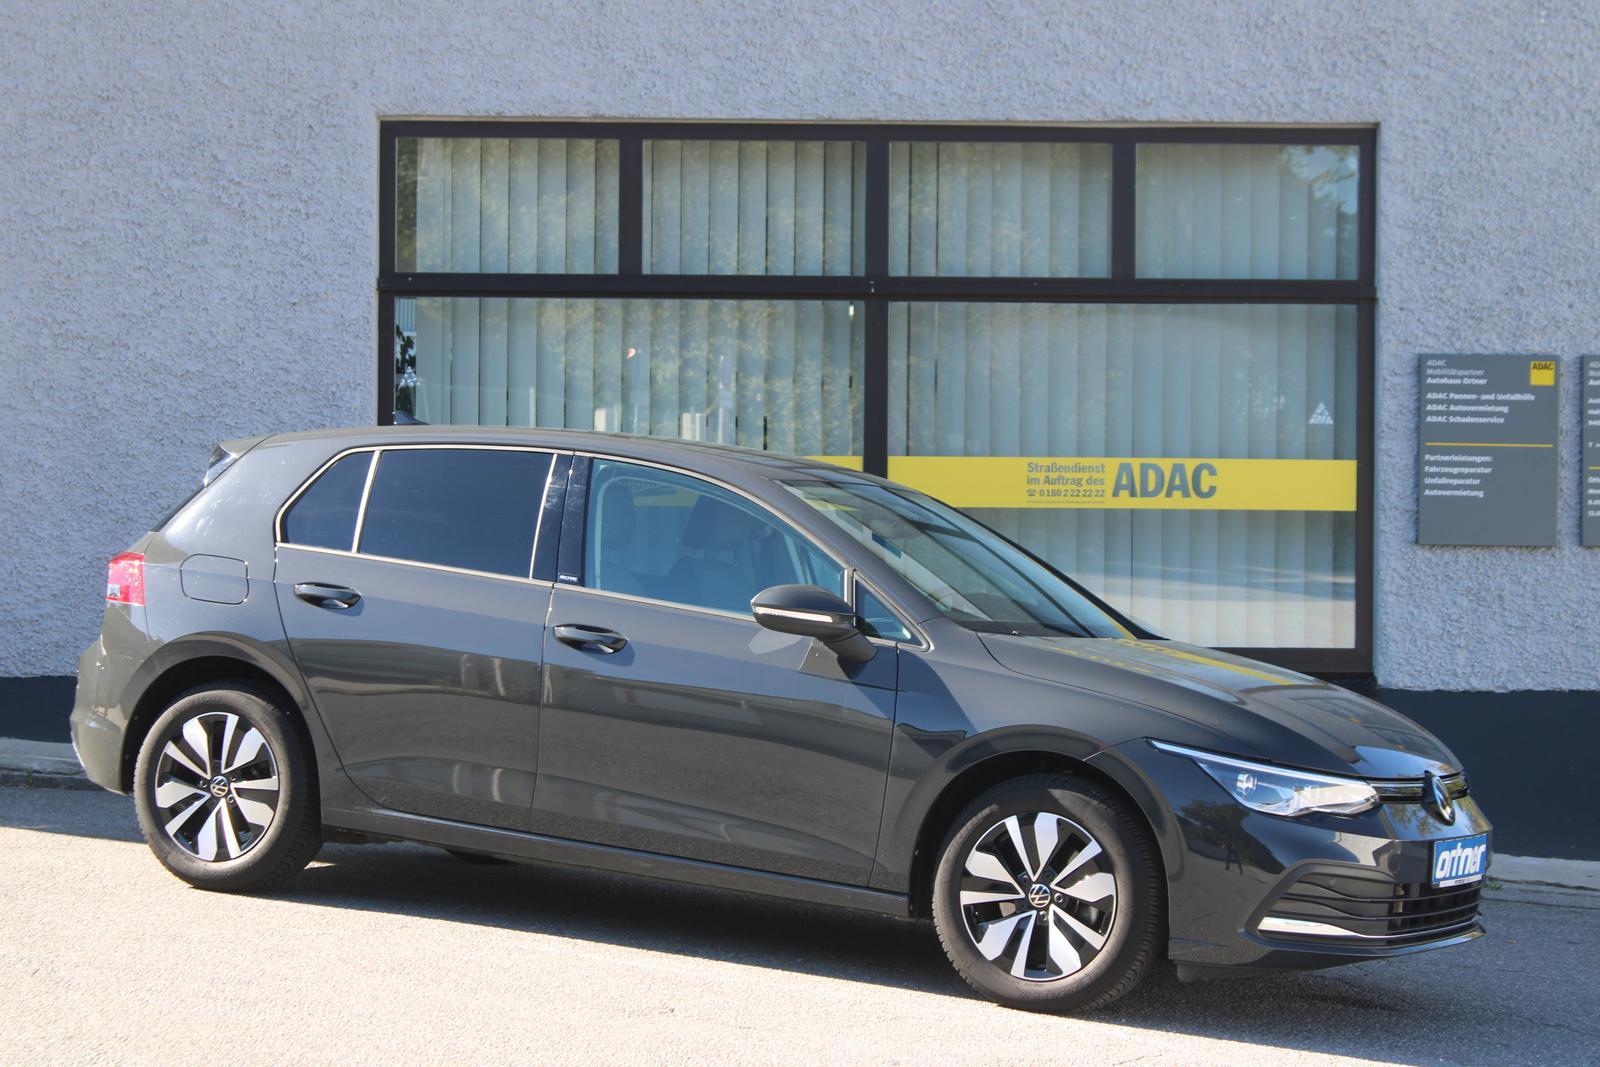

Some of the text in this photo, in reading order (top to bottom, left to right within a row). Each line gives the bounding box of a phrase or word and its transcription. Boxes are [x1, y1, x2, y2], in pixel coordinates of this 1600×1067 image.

[1532, 362, 1554, 370] ADAC
[1426, 377, 1488, 385] Autohaus Ortner
[1426, 392, 1448, 400] ADAC
[1449, 392, 1479, 400] Pannen-
[1496, 392, 1536, 401] Unfallhilfe
[1426, 403, 1509, 413] ADAC Autovermietung
[1426, 415, 1505, 424] ADAC Schadenservice
[1027, 462, 1105, 474] Straßendienst
[1424, 465, 1492, 474] Fahrzeugreparatur
[1026, 474, 1105, 488] im Auftrag des
[1111, 462, 1218, 500] ADAC
[1424, 476, 1481, 486] Unfallreparatur
[1424, 488, 1484, 498] Autovermietung
[1435, 842, 1487, 879] ortner
